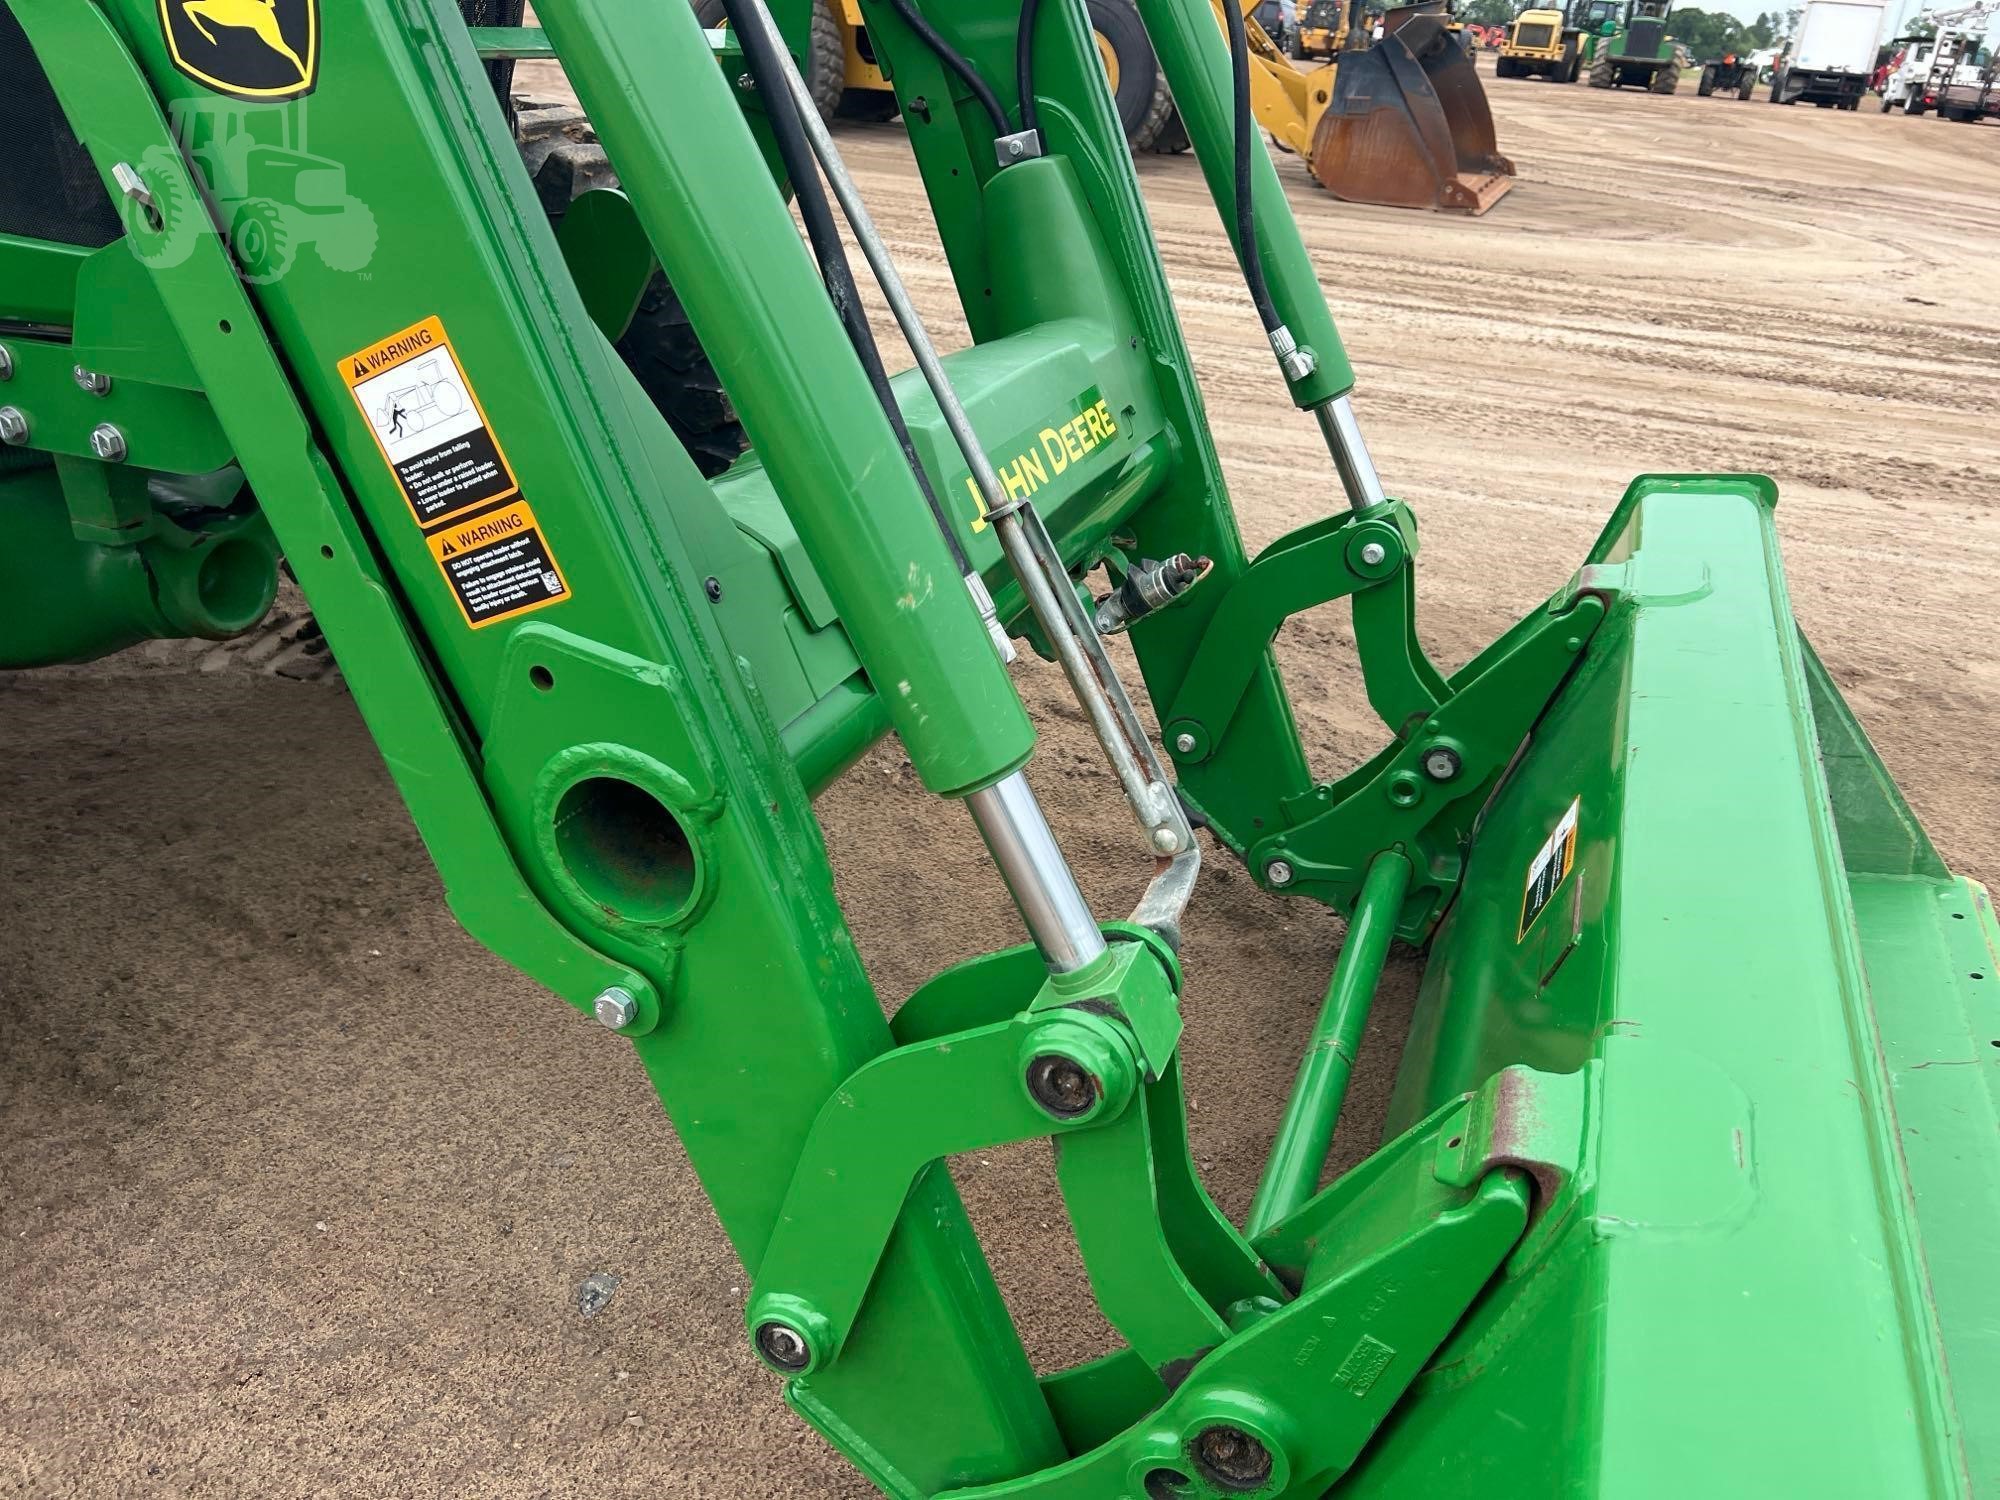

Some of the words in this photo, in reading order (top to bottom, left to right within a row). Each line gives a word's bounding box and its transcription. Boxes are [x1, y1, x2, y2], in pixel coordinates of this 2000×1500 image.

[367, 329, 432, 369] WARNING
[409, 460, 424, 471] avoid
[423, 455, 439, 464] injury
[438, 449, 453, 458] from
[452, 441, 470, 452] falling
[422, 477, 432, 485] not
[431, 471, 445, 481] walk
[451, 460, 474, 474] perform
[966, 447, 1049, 534] JHN
[1038, 399, 1116, 476] DEERE
[418, 485, 437, 496] service
[437, 478, 453, 488] under
[458, 467, 475, 479] raised
[475, 461, 495, 472] loader.
[421, 494, 438, 504] Lower
[438, 487, 455, 497] loader
[462, 475, 483, 489] ground
[482, 470, 498, 479] when
[457, 514, 522, 547] WARNING
[452, 562, 461, 570] DO
[461, 558, 474, 566] NOT
[473, 551, 494, 563] operate
[493, 546, 510, 556] loader
[510, 537, 530, 549] without
[461, 579, 479, 590] Failure
[485, 571, 505, 581] engage
[505, 564, 525, 574] retainer
[525, 557, 541, 568] could
[466, 588, 481, 597] result
[486, 576, 516, 589] attachment
[515, 568, 542, 580] detaching
[469, 597, 482, 605] from
[482, 590, 498, 600] loader
[499, 584, 520, 595] causing
[519, 578, 539, 588] serious
